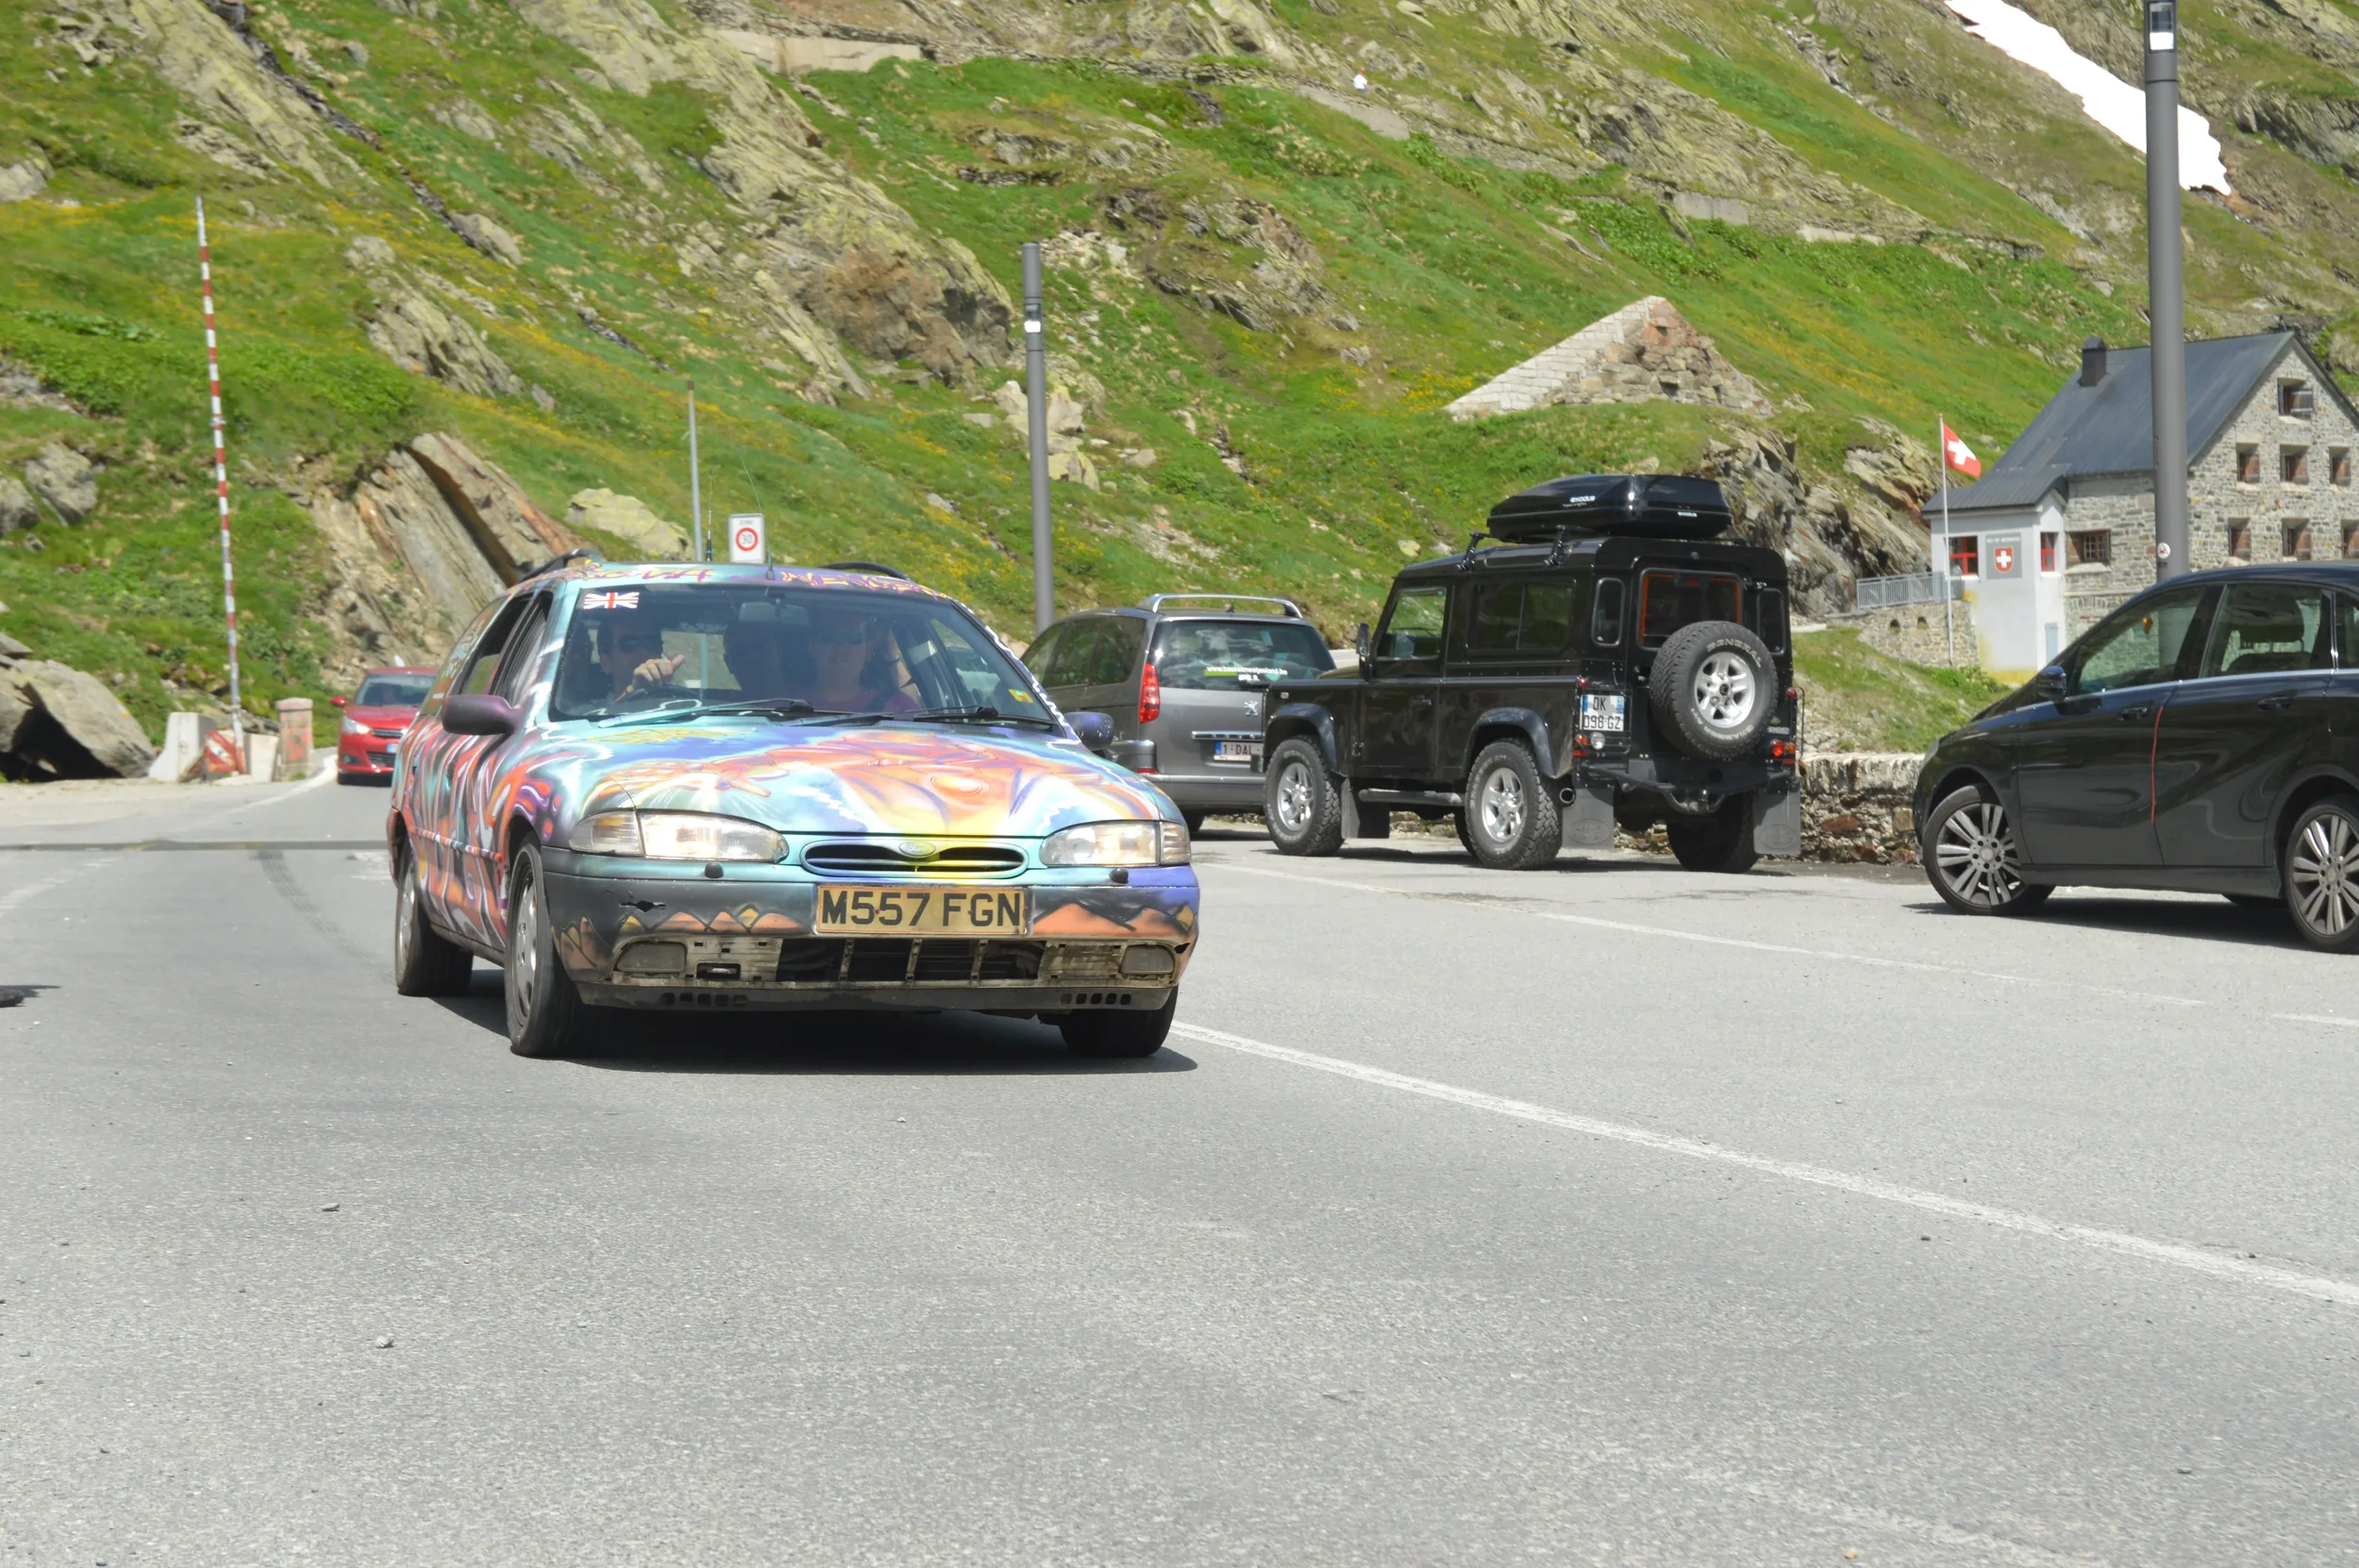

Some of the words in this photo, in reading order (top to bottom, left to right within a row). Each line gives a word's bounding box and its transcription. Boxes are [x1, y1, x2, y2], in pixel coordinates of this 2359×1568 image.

[741, 534, 753, 544] 30
[1706, 639, 1762, 668] GENERAL
[1593, 696, 1607, 711] DK
[821, 889, 930, 927] M557
[942, 892, 1021, 927] FGN
